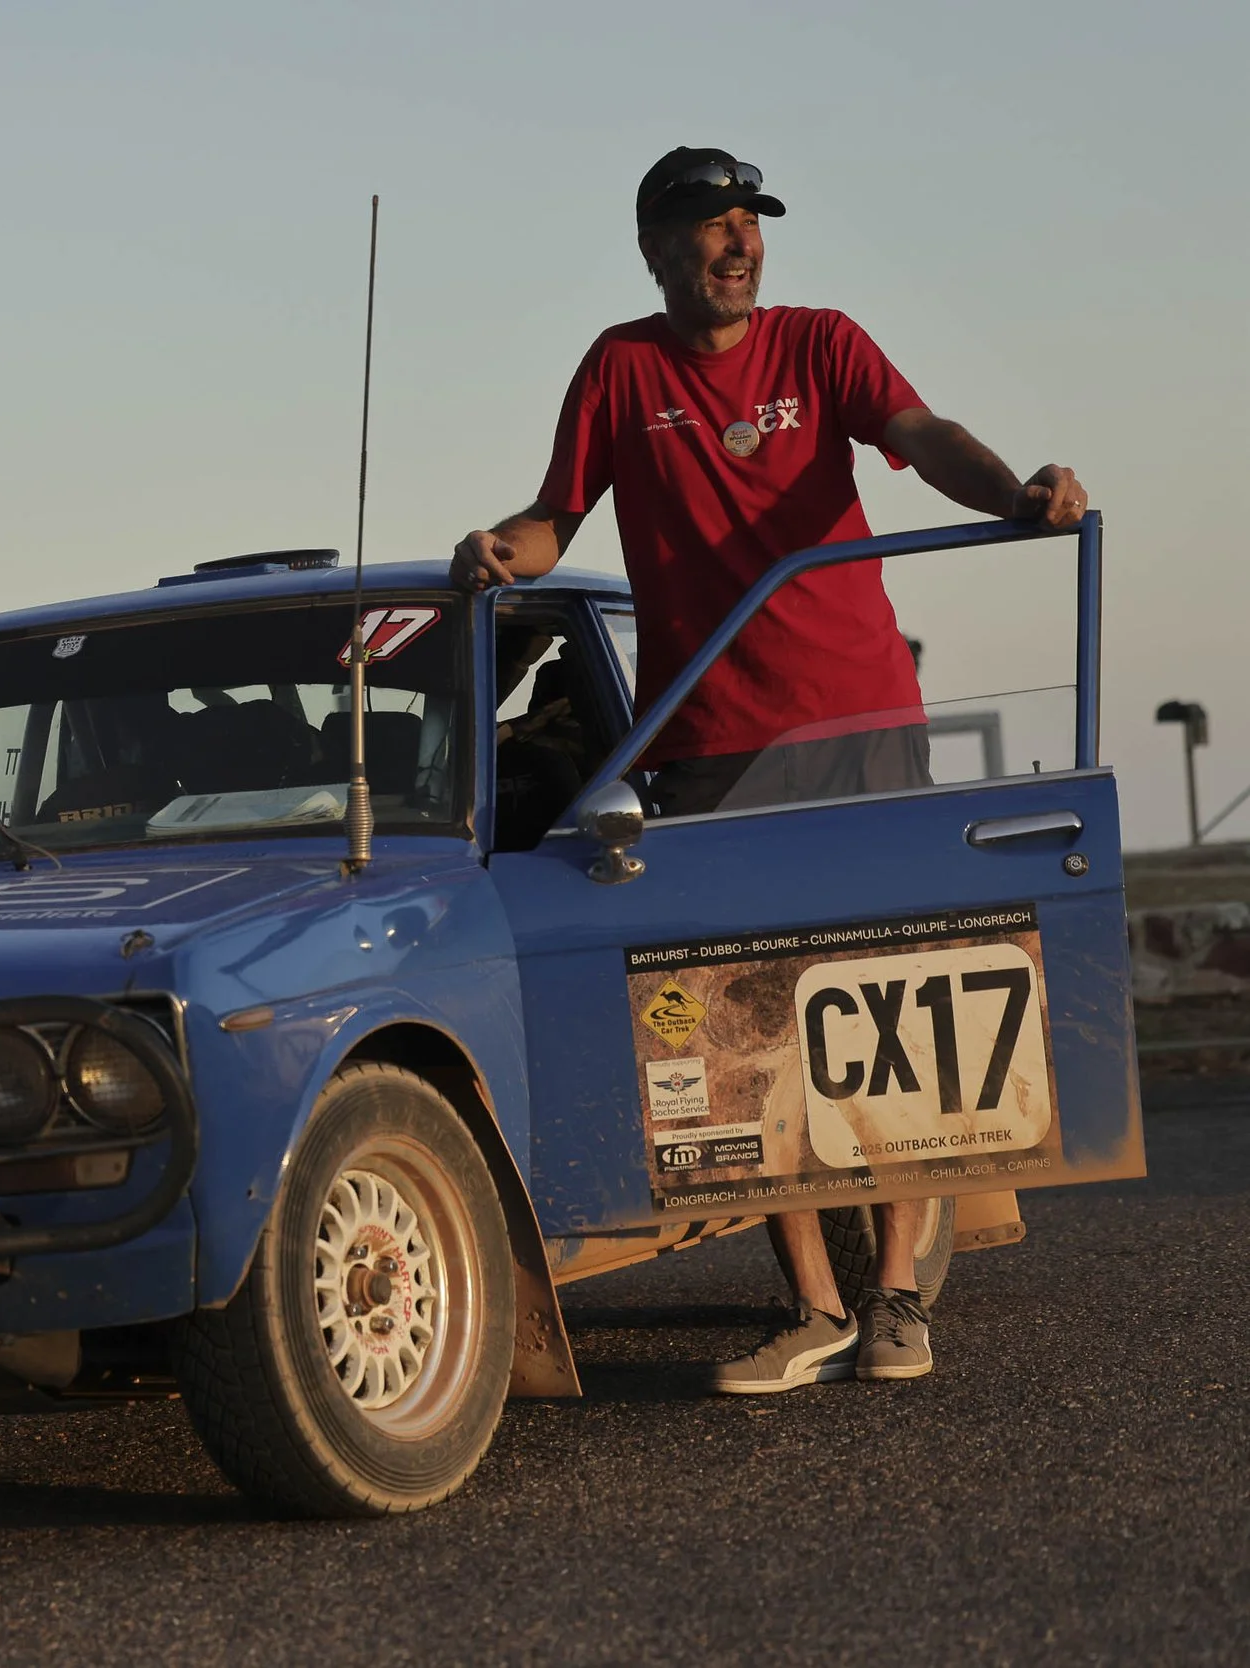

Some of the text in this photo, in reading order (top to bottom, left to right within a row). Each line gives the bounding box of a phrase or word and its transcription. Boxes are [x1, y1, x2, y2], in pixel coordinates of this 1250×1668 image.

[754, 397, 799, 415] TEAM
[757, 408, 801, 433] CX
[340, 609, 436, 659] 17
[631, 948, 689, 965] BATHURST
[700, 943, 742, 957] DUBBO
[752, 936, 800, 952] BOURKE
[810, 926, 892, 945] CUNNAMULLA
[902, 920, 948, 937] QUILPIE
[958, 911, 1031, 930] LONGREACH
[667, 1017, 696, 1026] Outback
[805, 967, 1031, 1114] CX17
[651, 1105, 710, 1117] Doctor Service
[655, 1096, 704, 1109] Royal Flying
[672, 1126, 744, 1141] Proudly sponsored by
[714, 1141, 758, 1153] MOVING
[852, 1129, 1012, 1157] 2025 OUTBACK CAR TREK
[715, 1151, 759, 1162] BRANDS
[664, 1191, 736, 1208] LONGREACH
[746, 1186, 778, 1199] JULIA
[779, 1182, 817, 1196] CREEK
[930, 1163, 996, 1180] CHILLAGOE
[1007, 1158, 1050, 1172] CAIRNS
